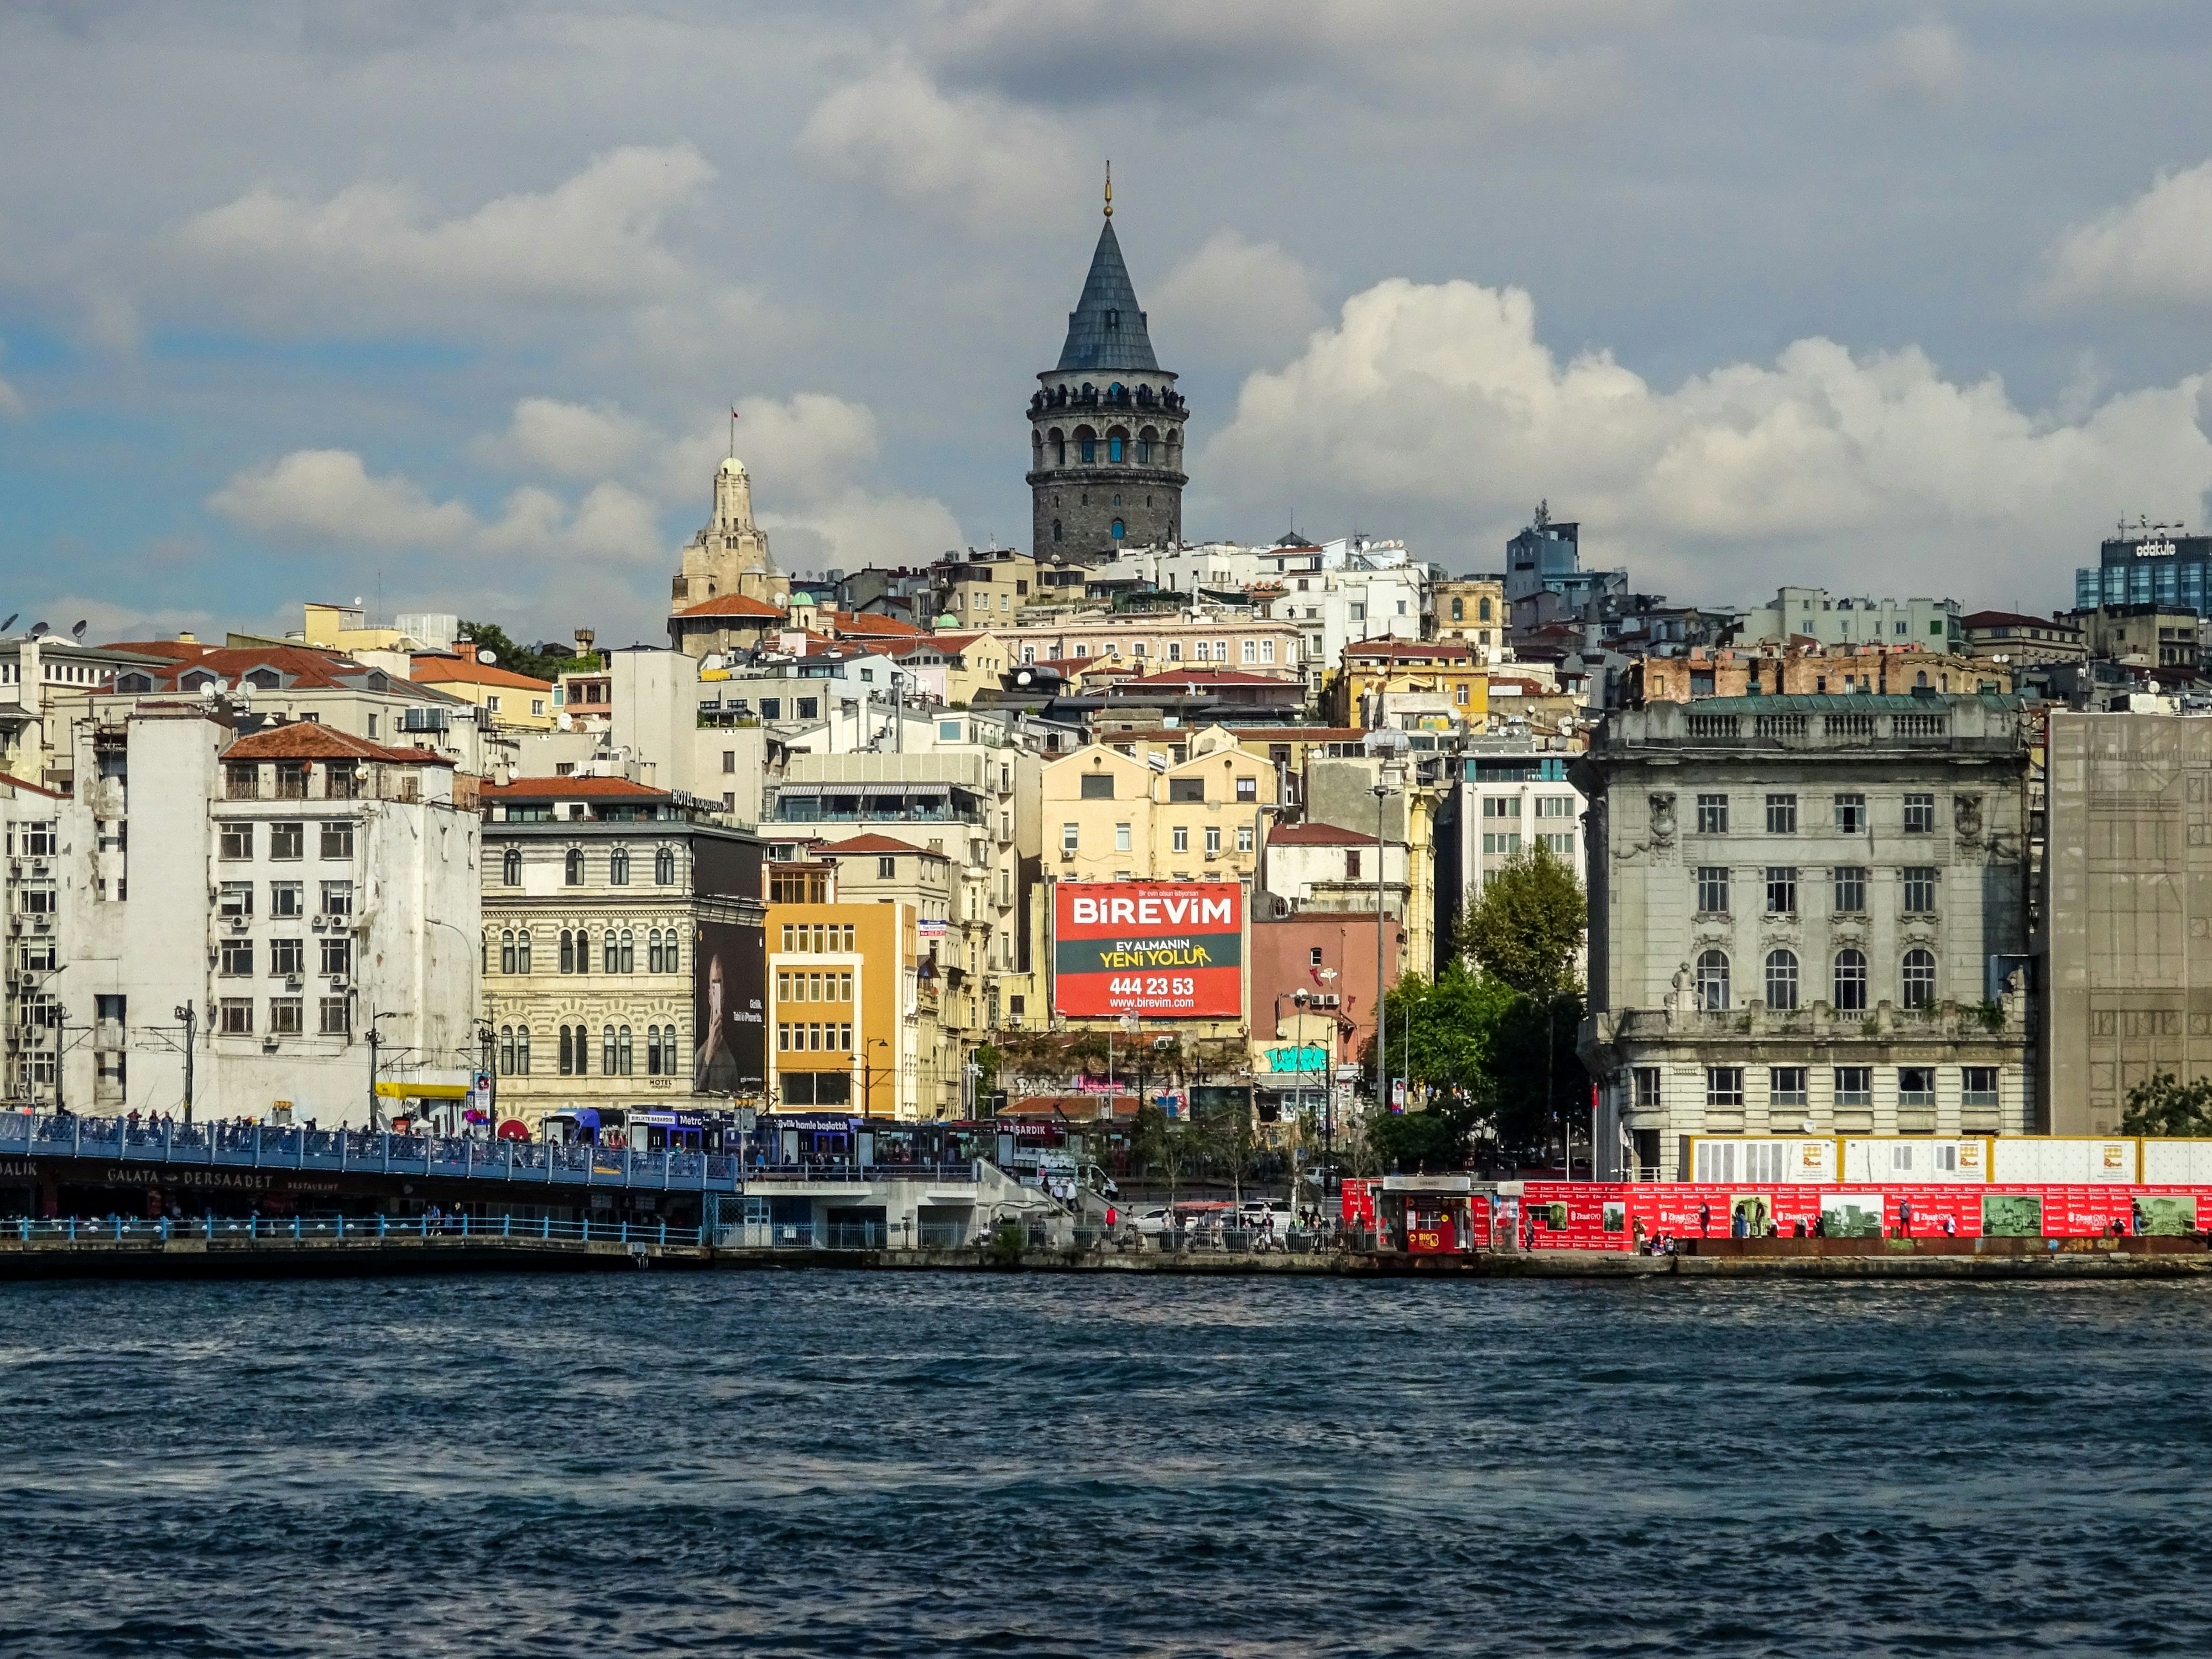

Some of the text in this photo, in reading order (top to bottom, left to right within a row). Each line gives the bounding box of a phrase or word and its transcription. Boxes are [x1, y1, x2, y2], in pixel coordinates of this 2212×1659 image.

[2136, 541, 2176, 557] odakule
[672, 789, 694, 807] HOTEL
[1117, 939, 1190, 952] EV ALMANIN
[1146, 950, 1197, 966] YOLU
[1110, 978, 1194, 995] 444 23 53
[1110, 997, 1194, 1008] www.birevim.com
[795, 1120, 816, 1129] hamle
[108, 1168, 159, 1182] GALATA
[184, 1172, 273, 1188] DERSAADET
